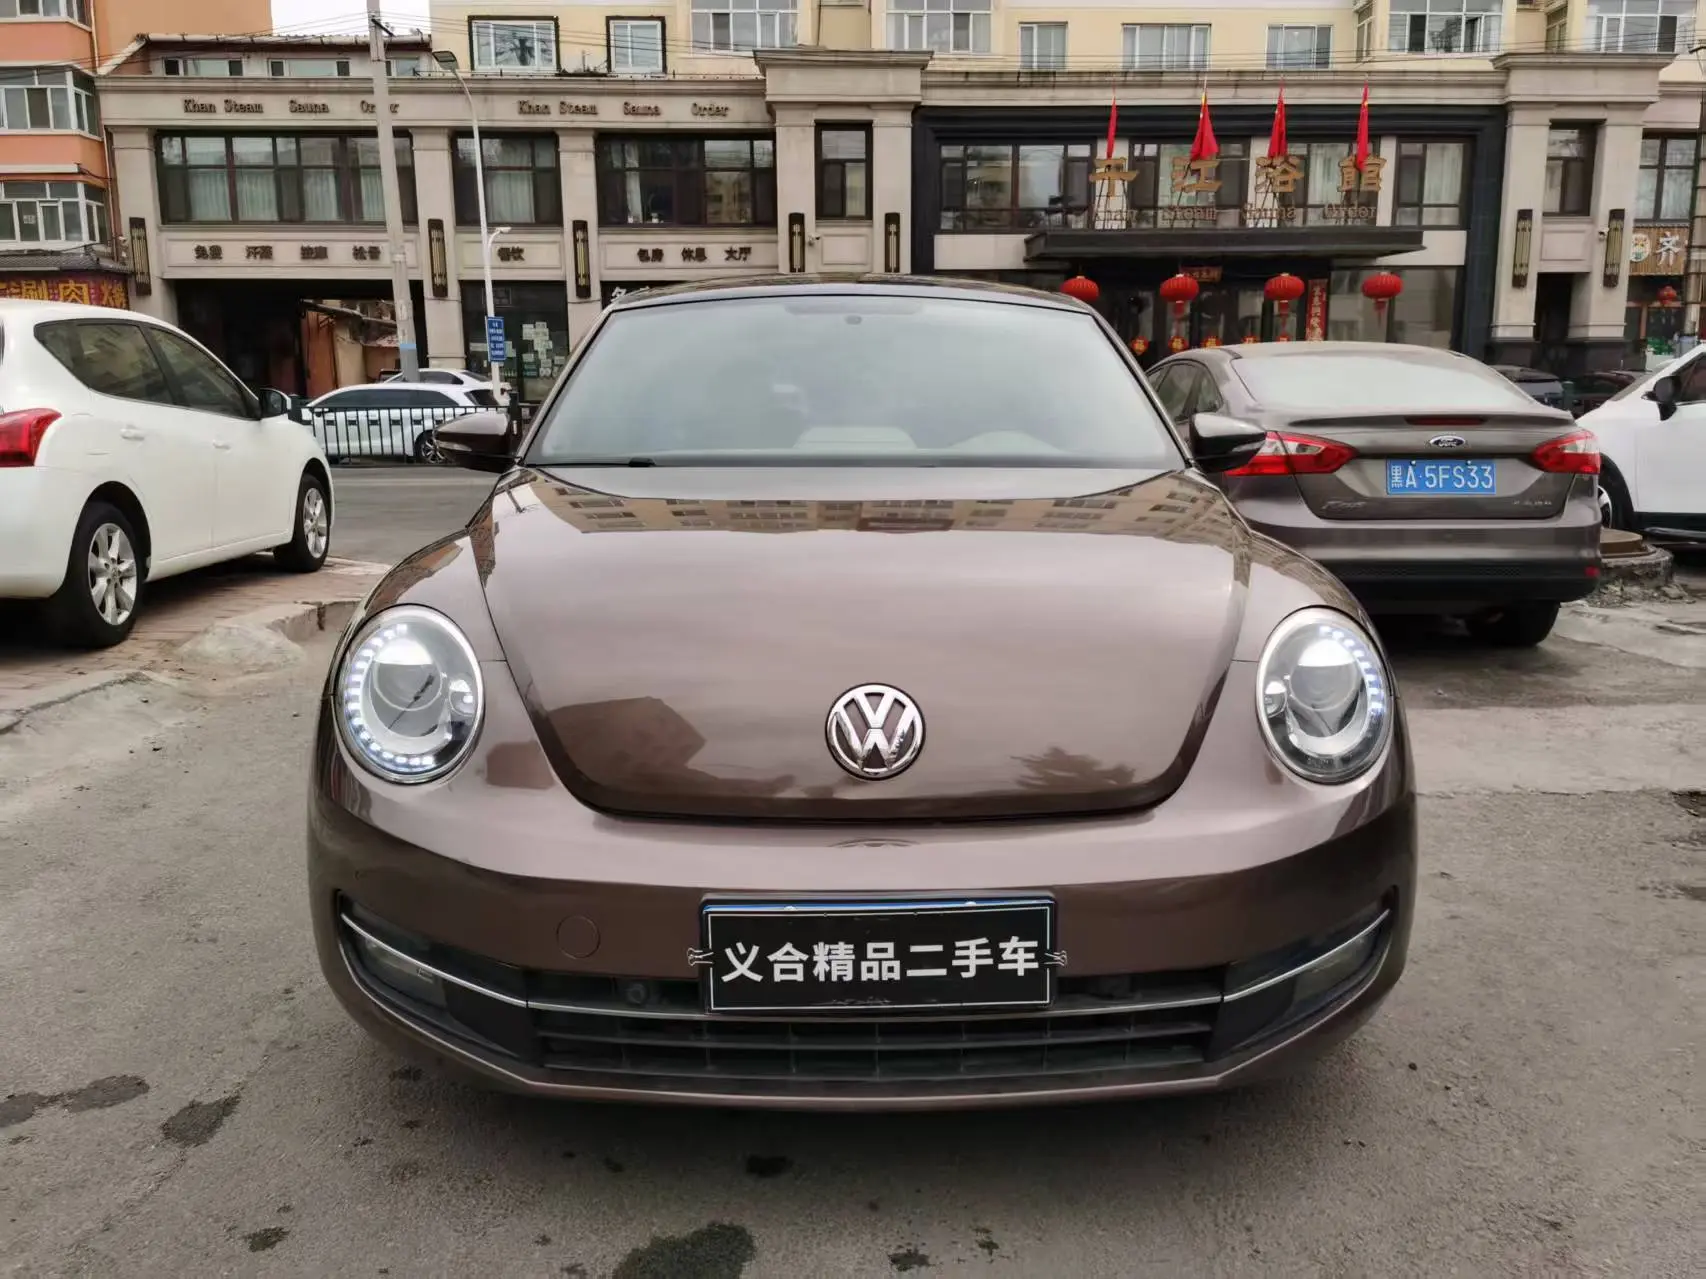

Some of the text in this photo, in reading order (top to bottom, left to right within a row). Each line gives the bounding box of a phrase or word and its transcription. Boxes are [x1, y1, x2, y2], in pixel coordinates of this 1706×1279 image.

[184, 99, 398, 113] Khan Steam Sauna Orr
[517, 101, 730, 117] Khan Steam Sauna Order
[681, 247, 708, 262] 休息
[725, 246, 752, 261] 大厅
[721, 936, 1040, 982] 义合精品二手车
